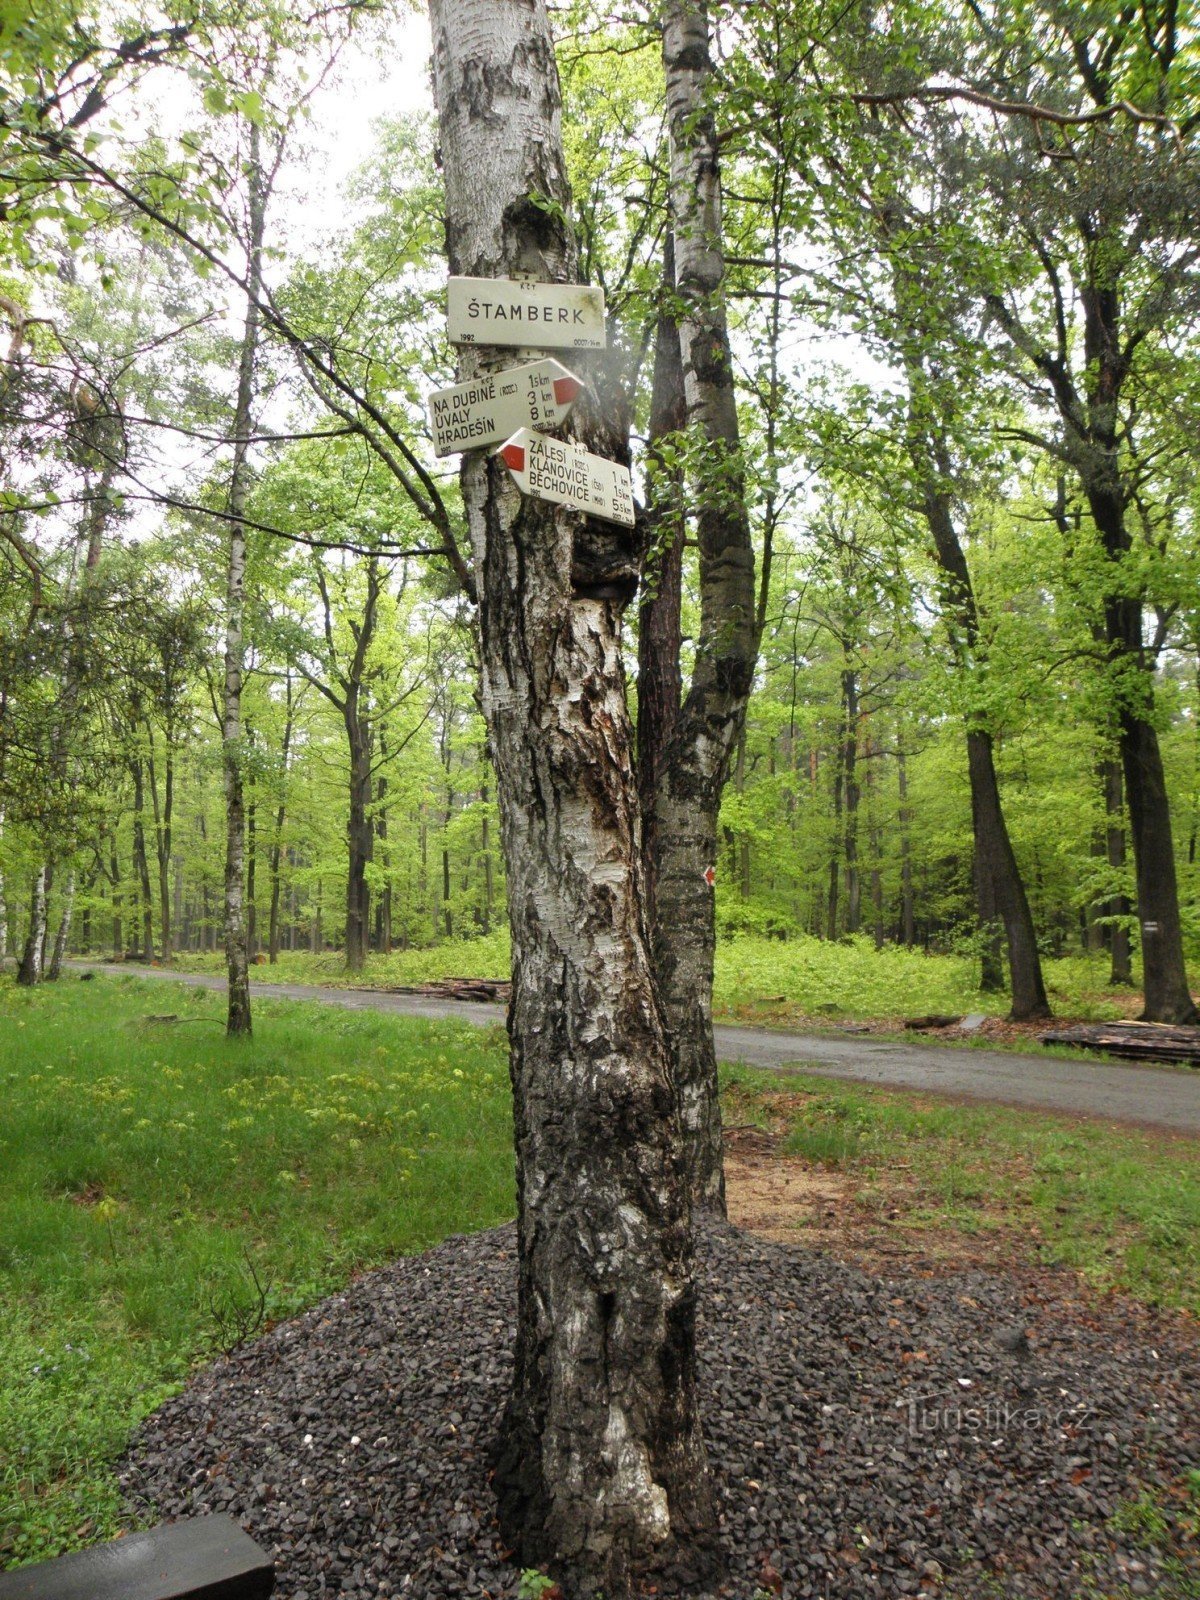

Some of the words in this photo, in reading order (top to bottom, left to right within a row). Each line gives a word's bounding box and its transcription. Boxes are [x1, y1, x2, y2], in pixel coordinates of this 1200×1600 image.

[468, 298, 585, 325] ŠTAMBERK
[434, 400, 449, 414] NA
[453, 385, 496, 409] DUBINĚ
[435, 408, 470, 429] ÚVALY
[527, 391, 537, 405] 3
[541, 390, 553, 402] km
[437, 417, 495, 445] HRADEŠÍN
[530, 407, 539, 420] 8
[544, 406, 555, 418] km
[529, 440, 567, 464] ZÁLESÍ
[612, 471, 617, 483] 1
[620, 475, 628, 487] km
[529, 455, 588, 487] KLÁNOVICE
[529, 470, 589, 502] BĚCHOVICE
